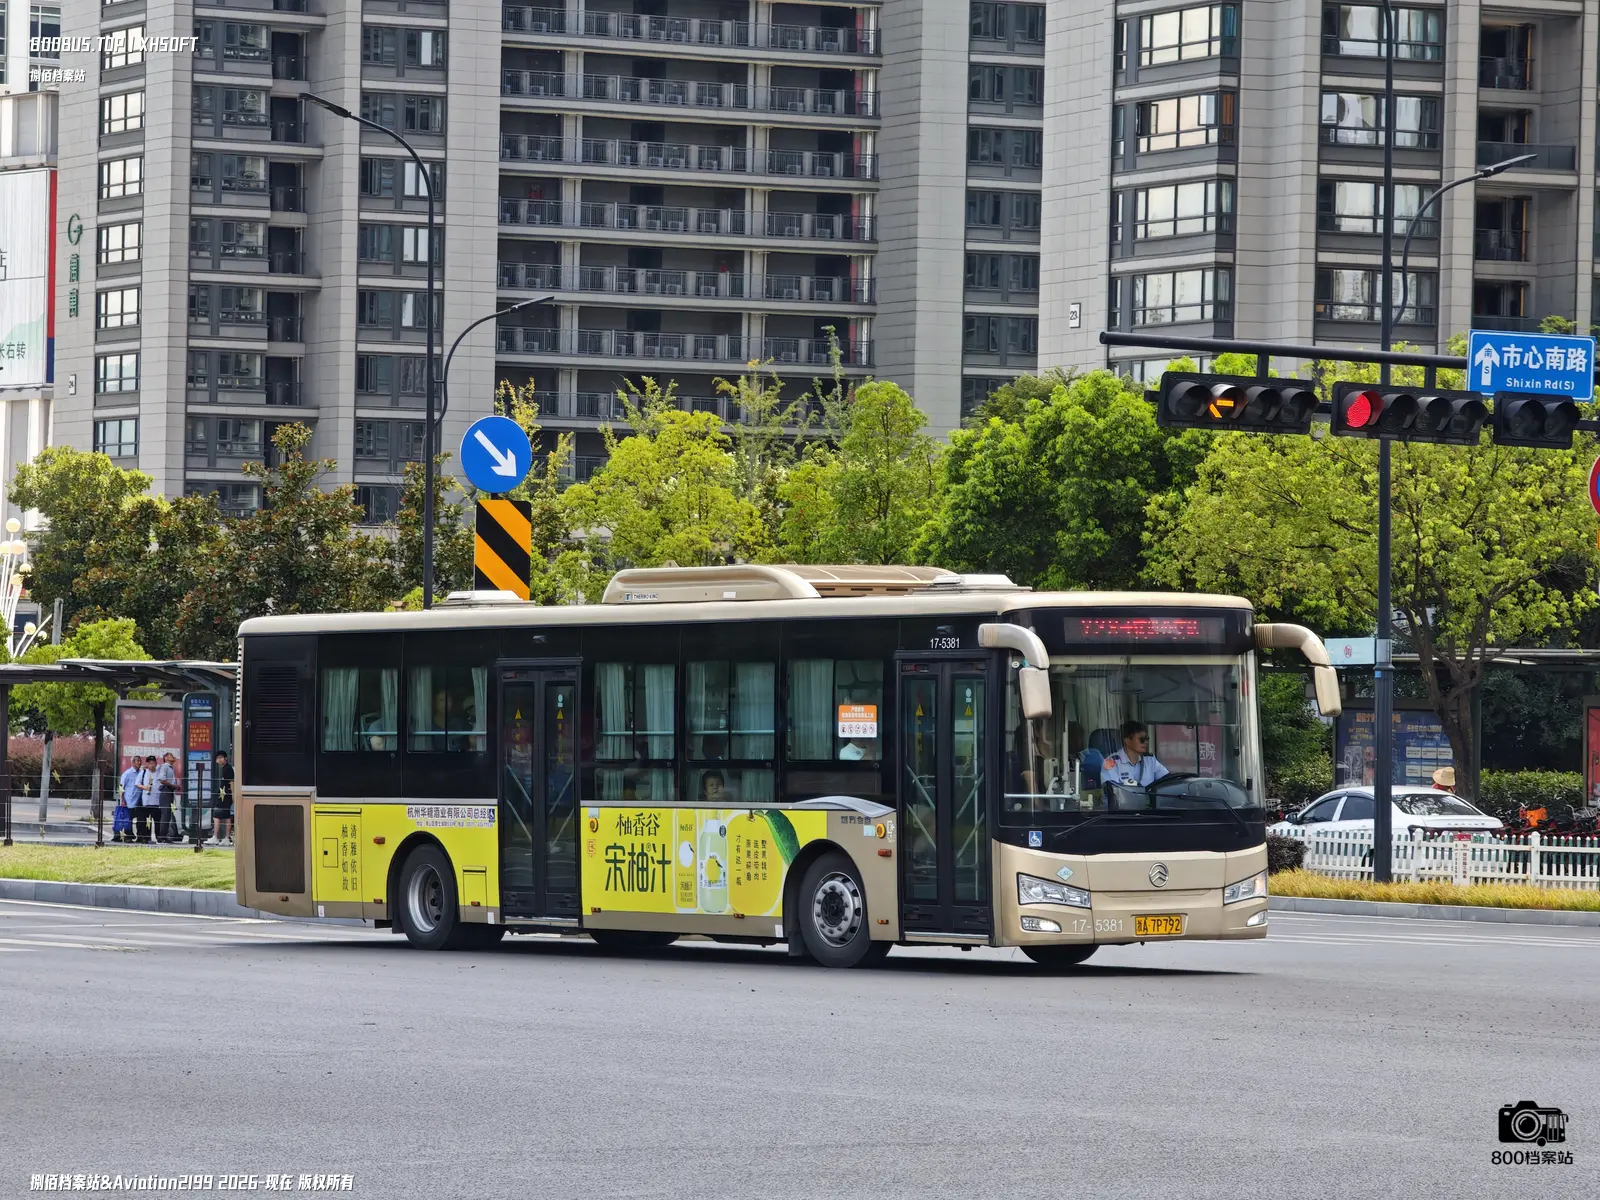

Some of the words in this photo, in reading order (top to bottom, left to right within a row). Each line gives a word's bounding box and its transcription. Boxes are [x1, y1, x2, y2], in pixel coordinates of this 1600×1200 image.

[1070, 310, 1078, 320] 23
[1484, 347, 1492, 358] 南
[1502, 344, 1588, 372] 市心南路
[1484, 366, 1490, 374] S
[1506, 378, 1541, 389] Shixin
[1544, 380, 1575, 390] Rd(S)
[930, 637, 960, 649] 17-5381
[616, 812, 660, 836] 柚香谷
[604, 843, 672, 893] 宋柚汁
[1072, 919, 1124, 932] 17-5381
